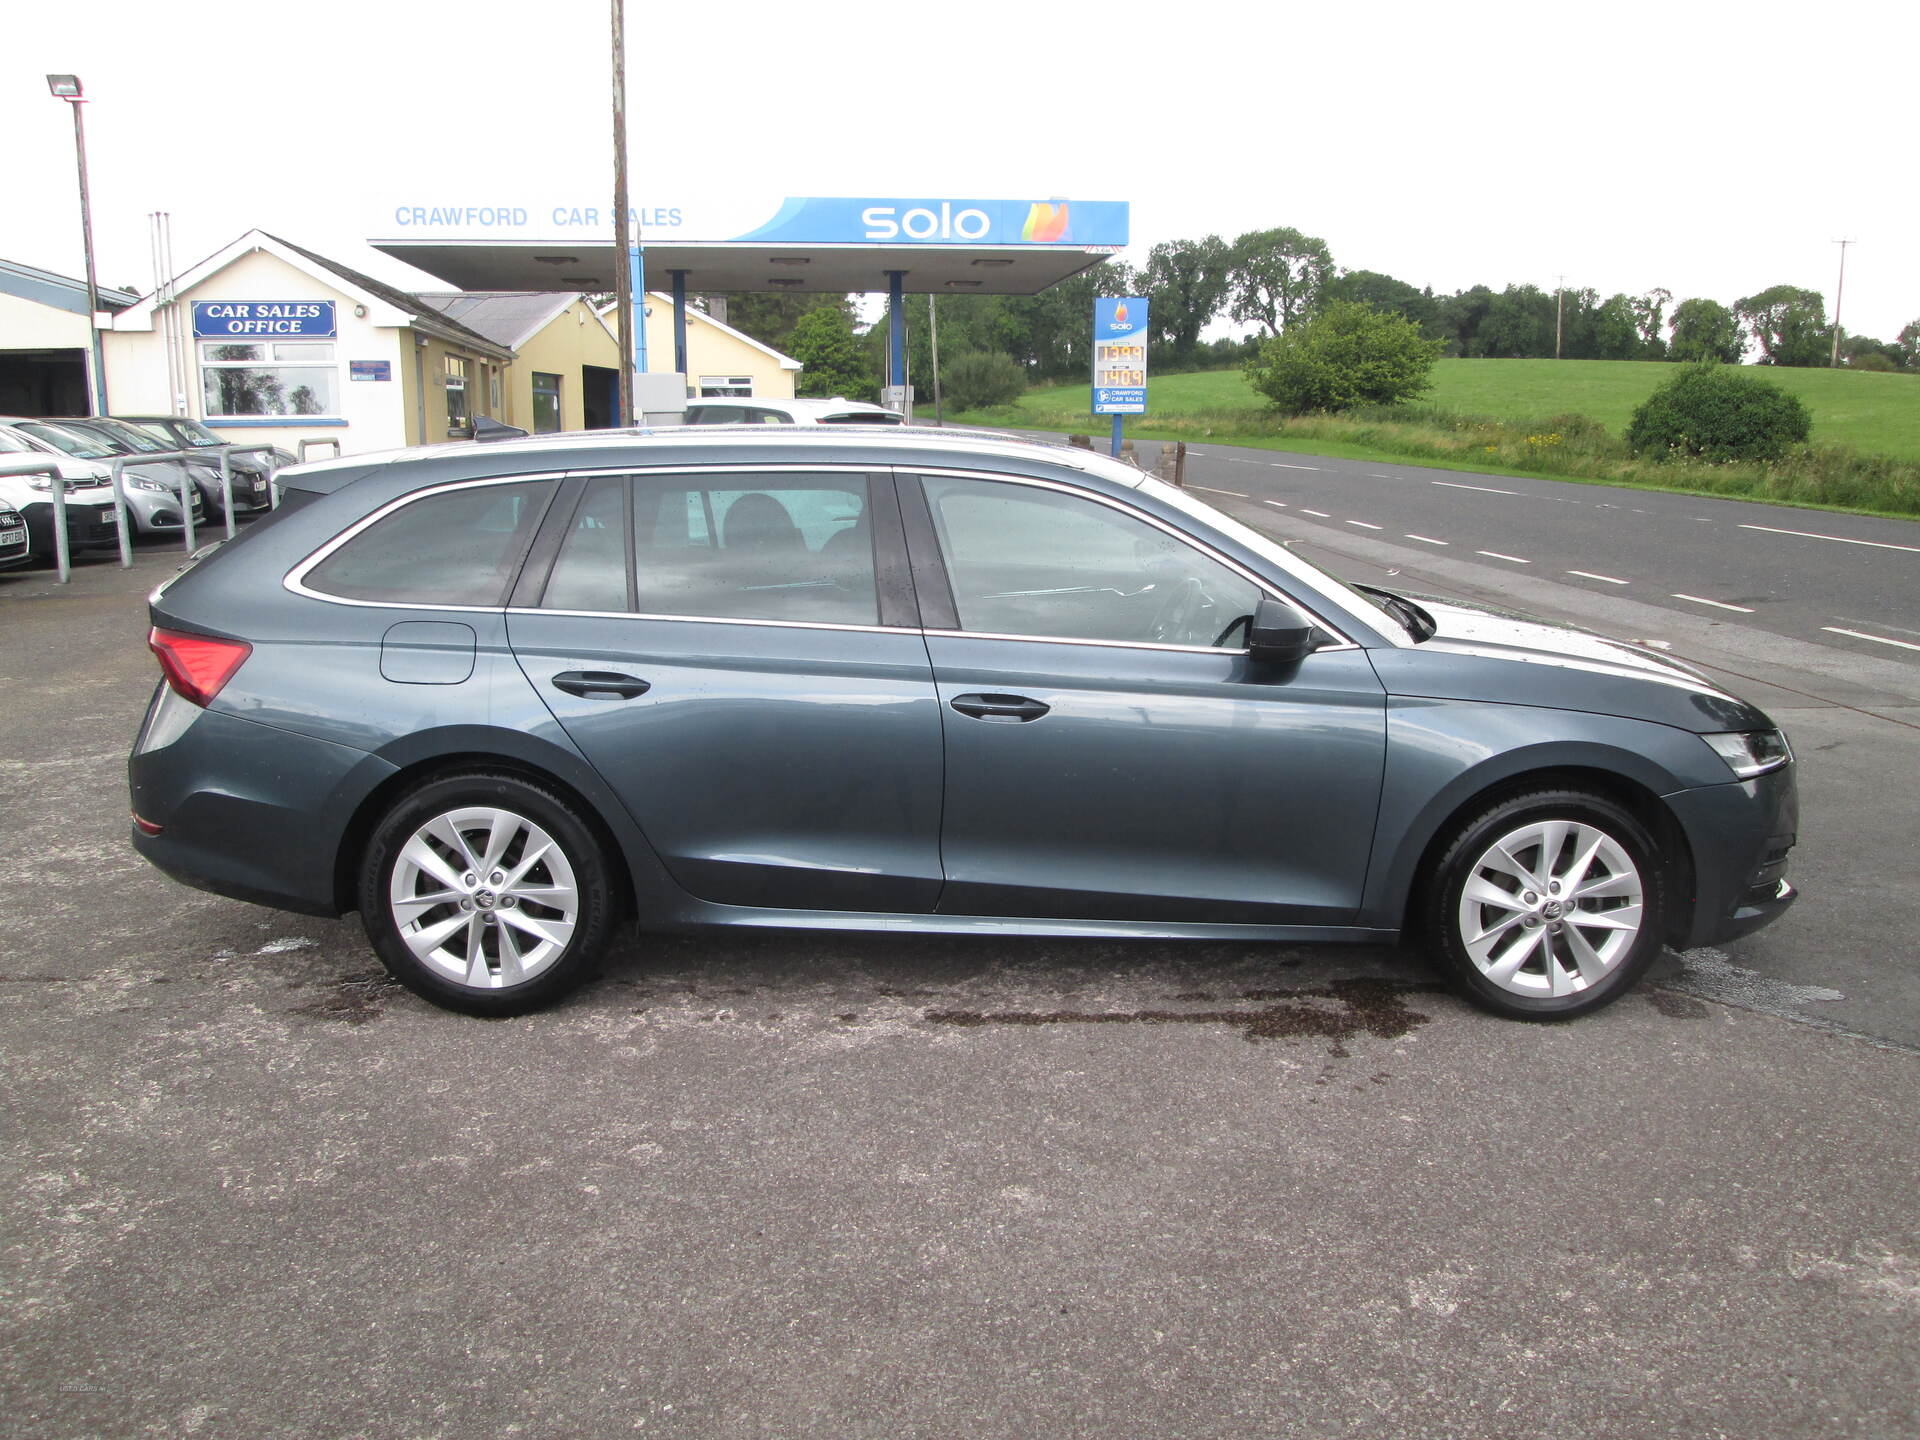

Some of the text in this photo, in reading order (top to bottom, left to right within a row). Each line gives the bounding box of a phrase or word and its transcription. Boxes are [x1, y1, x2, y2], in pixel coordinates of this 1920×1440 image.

[395, 206, 528, 226] CRAWFORD
[552, 207, 599, 226] CAR
[862, 201, 990, 239] solo
[207, 304, 321, 318] CAR SALES
[228, 320, 302, 333] OFFICE
[1110, 322, 1132, 330] solo
